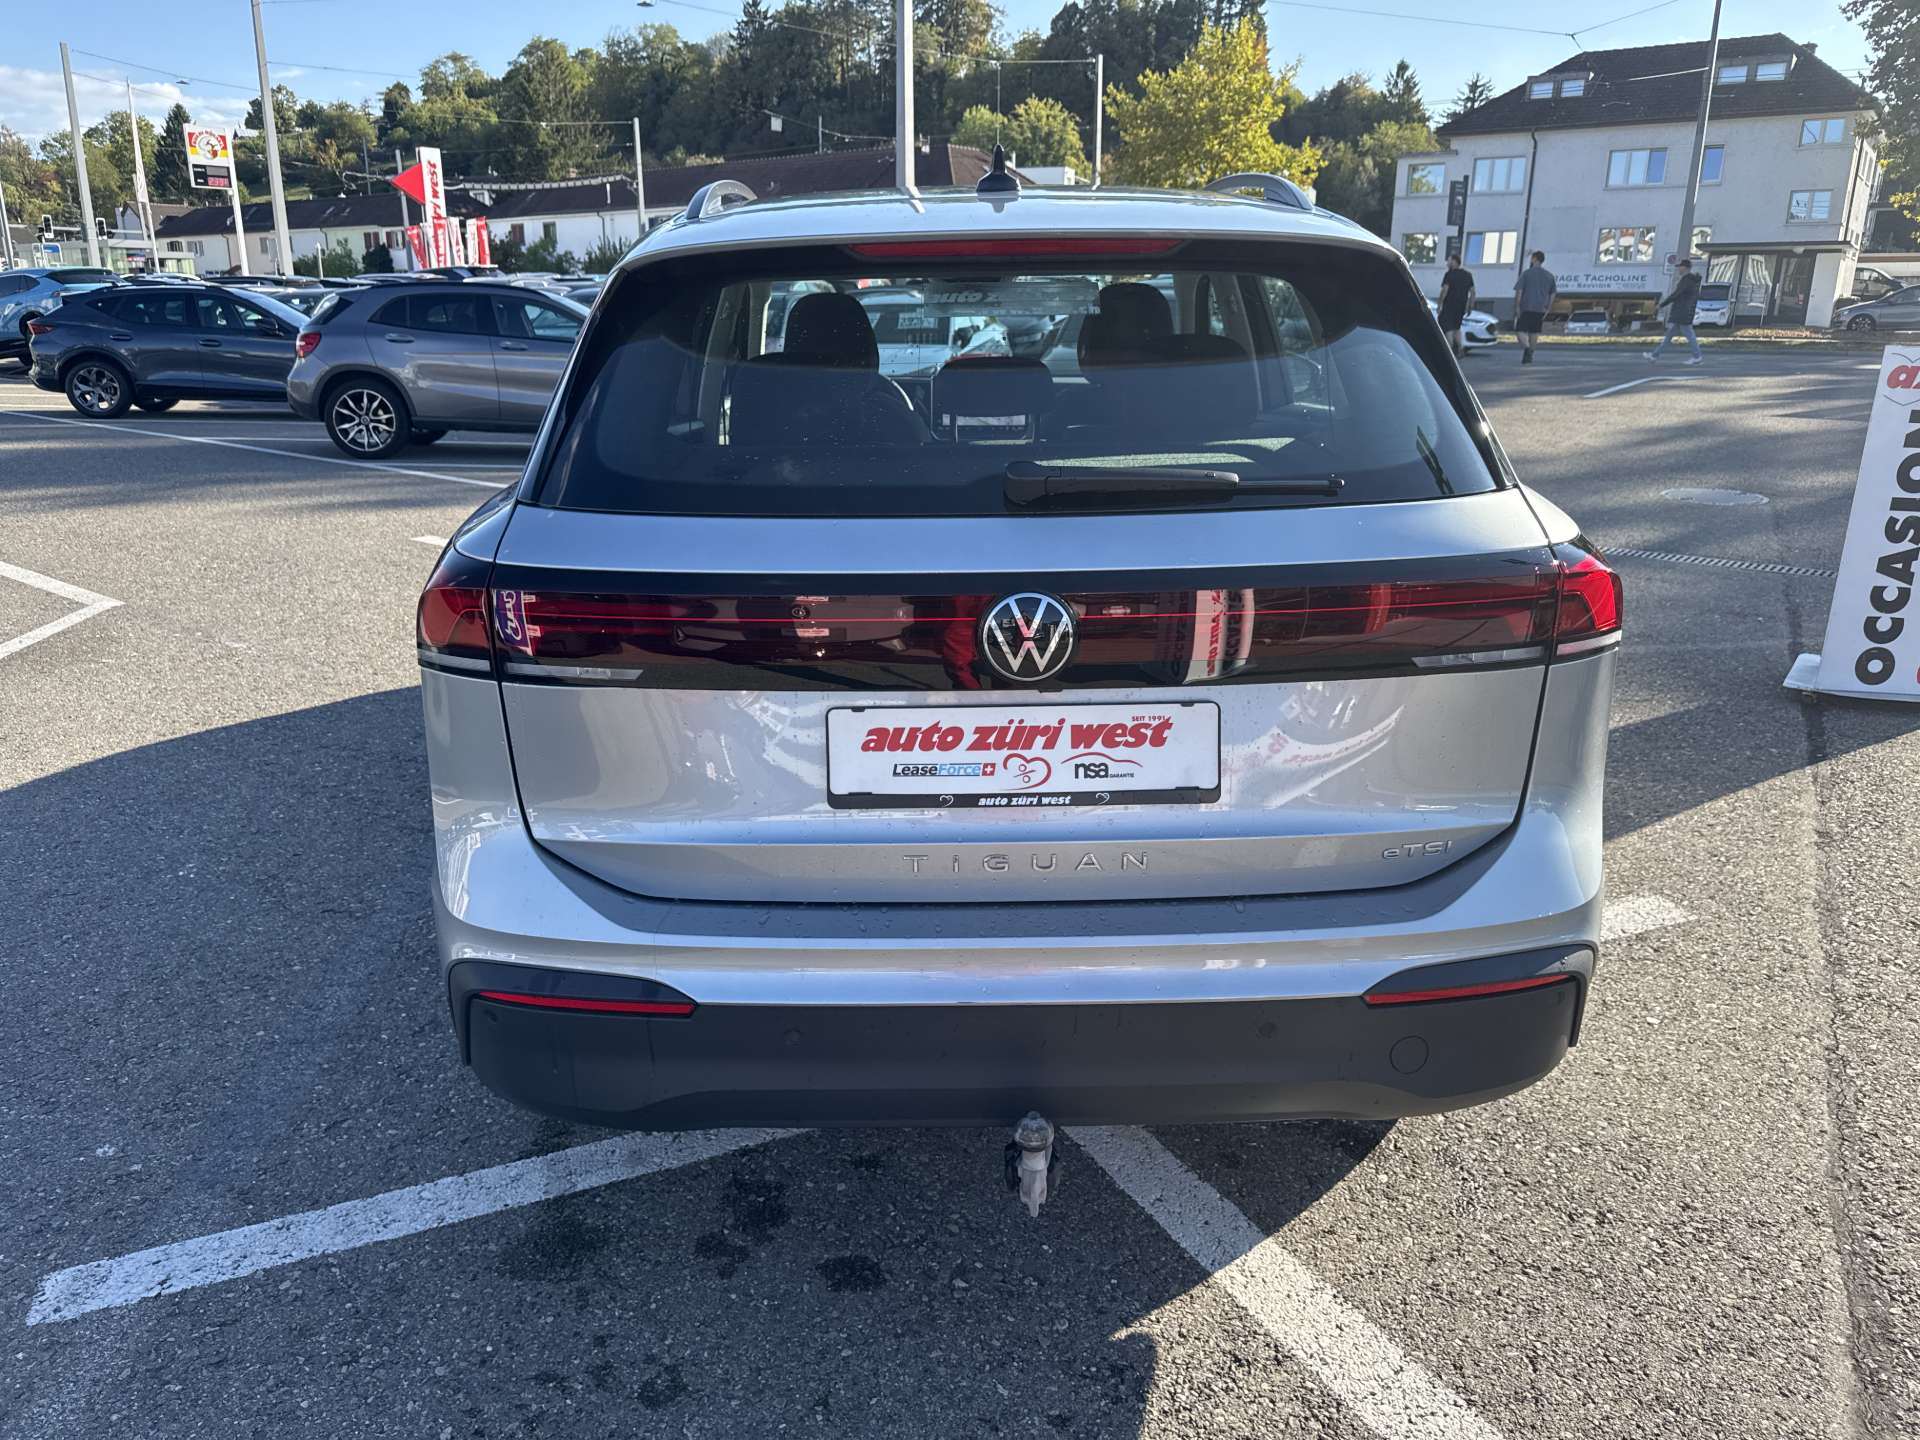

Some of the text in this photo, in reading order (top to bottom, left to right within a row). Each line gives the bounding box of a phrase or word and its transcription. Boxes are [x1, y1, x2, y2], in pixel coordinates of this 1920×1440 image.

[1584, 273, 1648, 282] TACHOLINE
[984, 593, 1073, 680] VW
[1148, 714, 1166, 722] 1991
[861, 716, 1174, 752] auto züri west
[892, 762, 981, 777] LeaseForce
[1074, 762, 1109, 779] nsa
[978, 794, 1072, 806] auto züri west
[1382, 840, 1453, 859] eTSI
[903, 851, 1149, 874] TIGUAN
